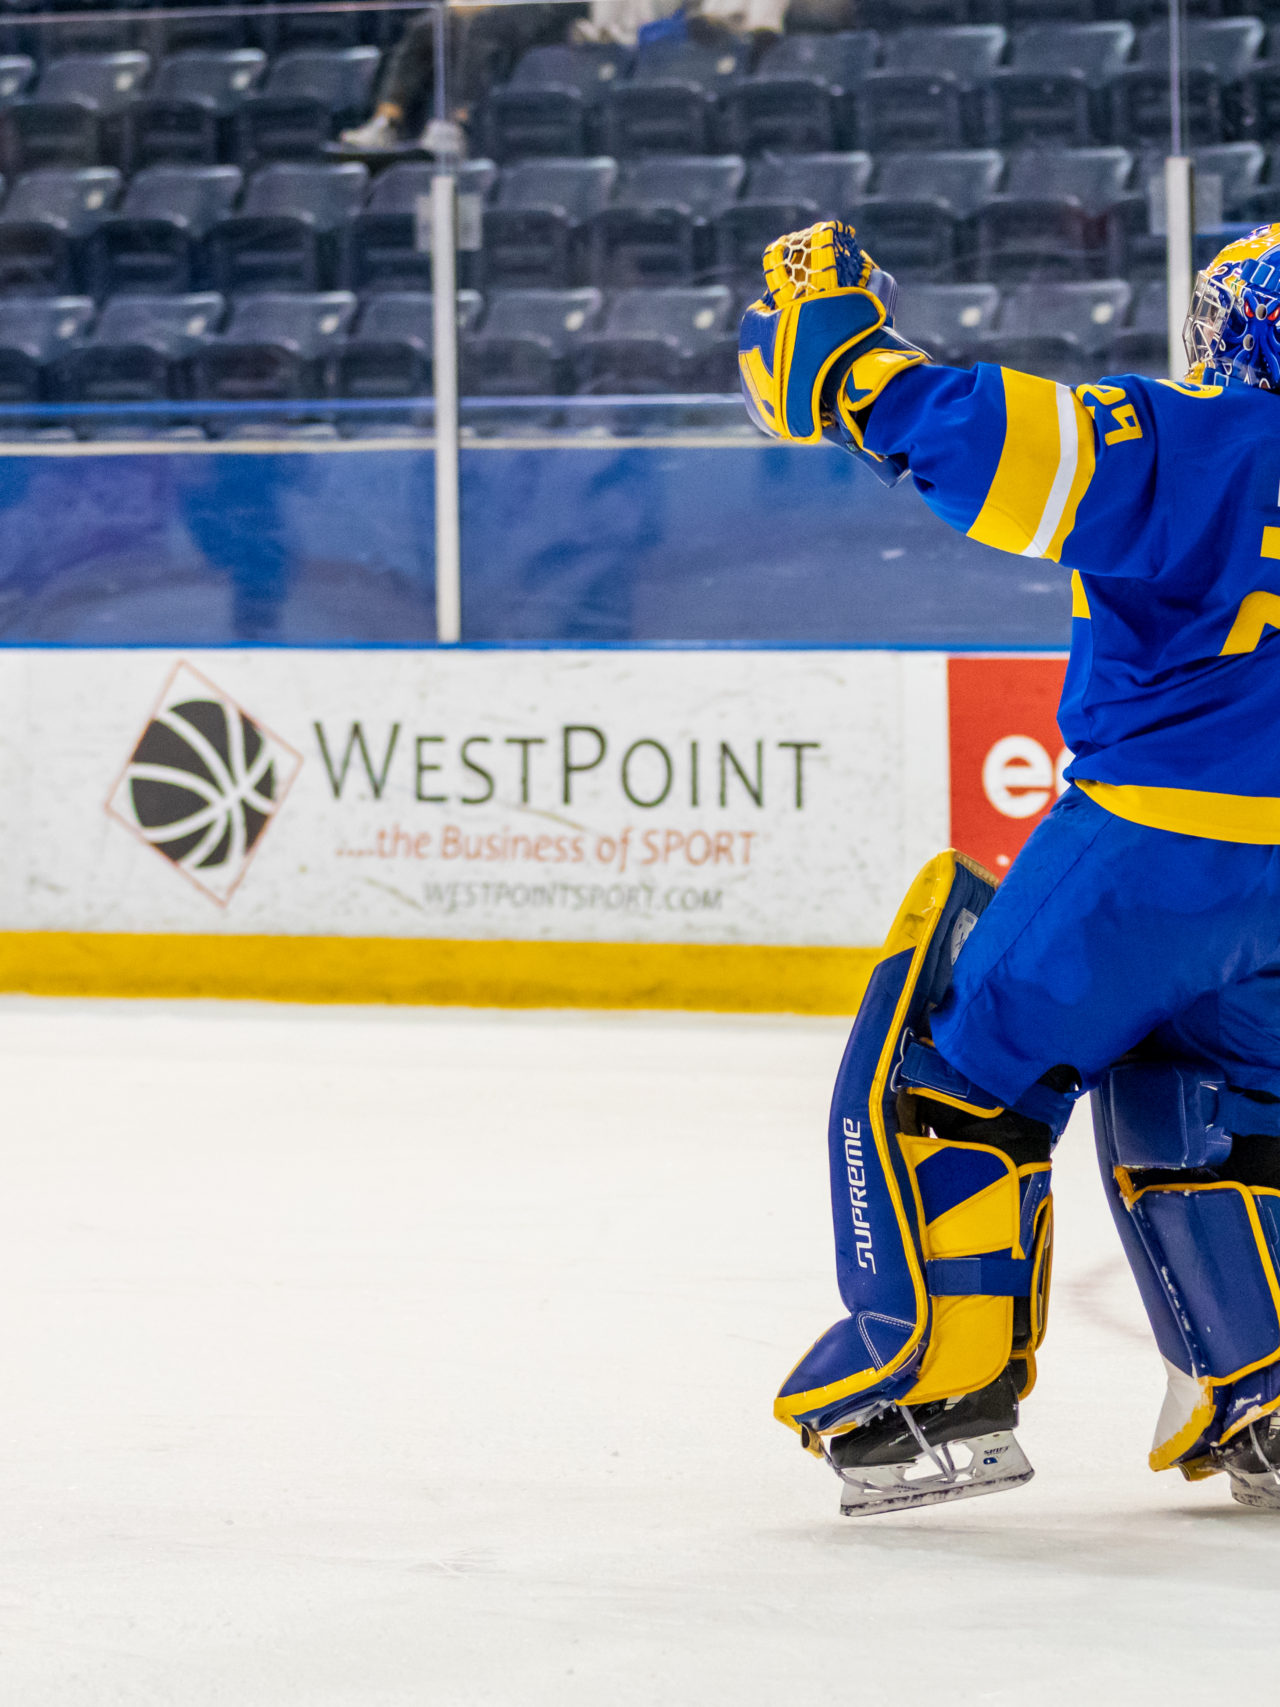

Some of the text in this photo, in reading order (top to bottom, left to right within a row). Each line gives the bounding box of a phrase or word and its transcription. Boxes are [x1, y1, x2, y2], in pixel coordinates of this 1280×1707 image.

[981, 734, 1075, 819] e
[440, 825, 585, 864] Business
[598, 826, 637, 873] of
[640, 828, 758, 867] SPORT
[843, 1117, 877, 1275] SUPREME
